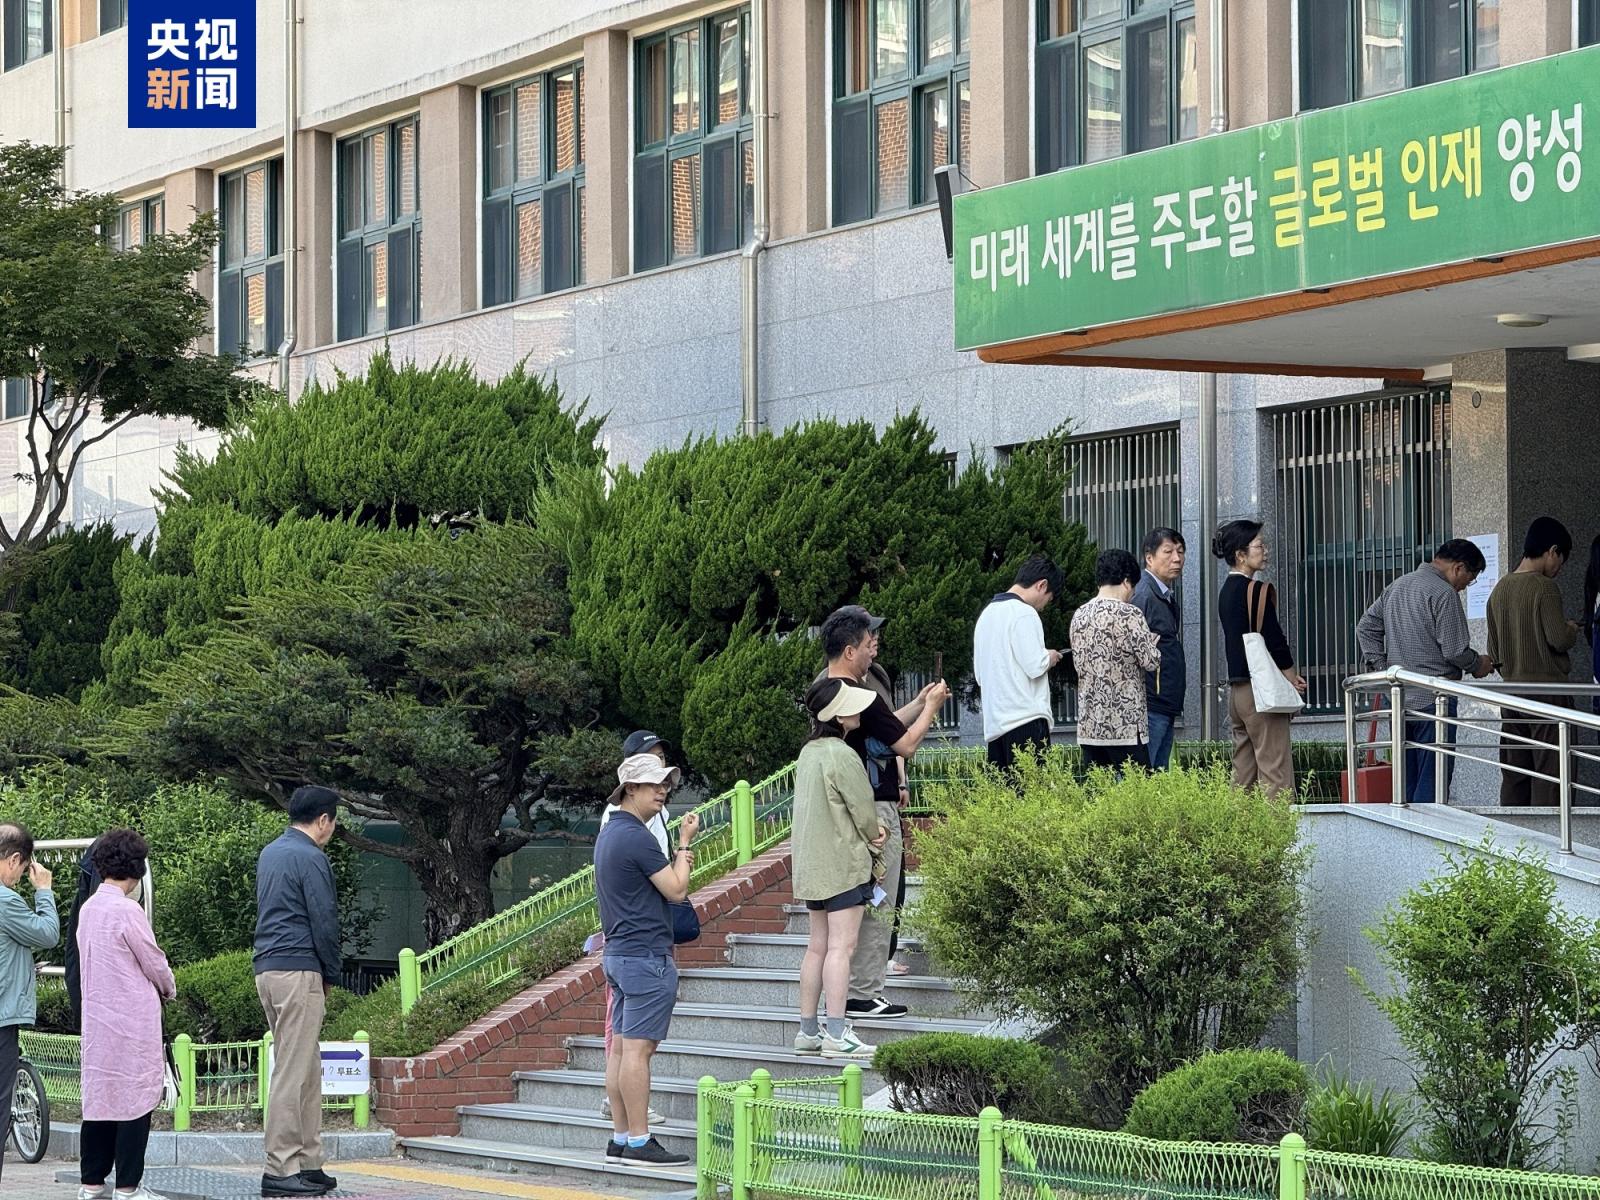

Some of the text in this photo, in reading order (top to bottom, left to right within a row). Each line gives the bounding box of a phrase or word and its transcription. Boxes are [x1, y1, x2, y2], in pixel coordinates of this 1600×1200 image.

[971, 103, 1583, 292] 미래 세계를 주도할 글로벌 인재 양성
[337, 1067, 362, 1076] 투표소
